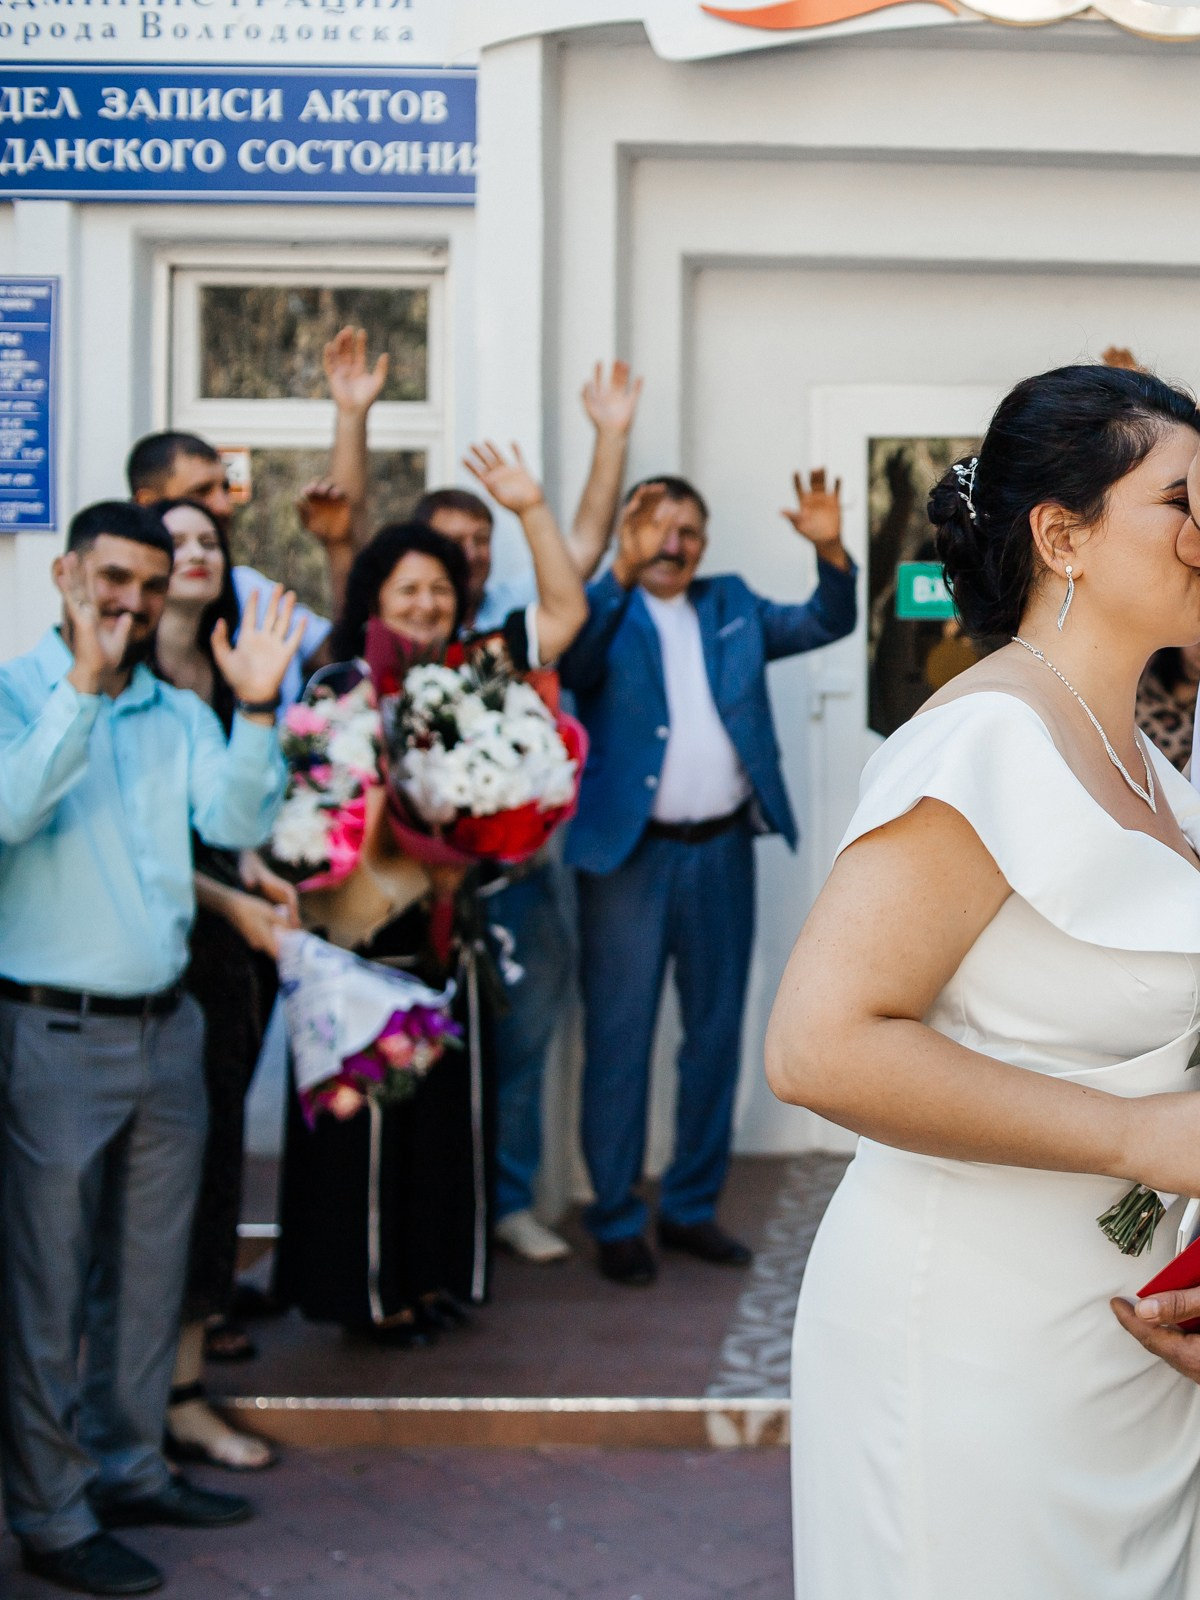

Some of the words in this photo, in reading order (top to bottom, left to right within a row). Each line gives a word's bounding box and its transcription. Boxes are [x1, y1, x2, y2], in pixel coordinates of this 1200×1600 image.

[141, 11, 414, 43] Волгодонска
[97, 86, 284, 122] ЗАПИСИ
[298, 88, 449, 125] АКТОВ
[0, 137, 227, 176] ДАНСКОГО
